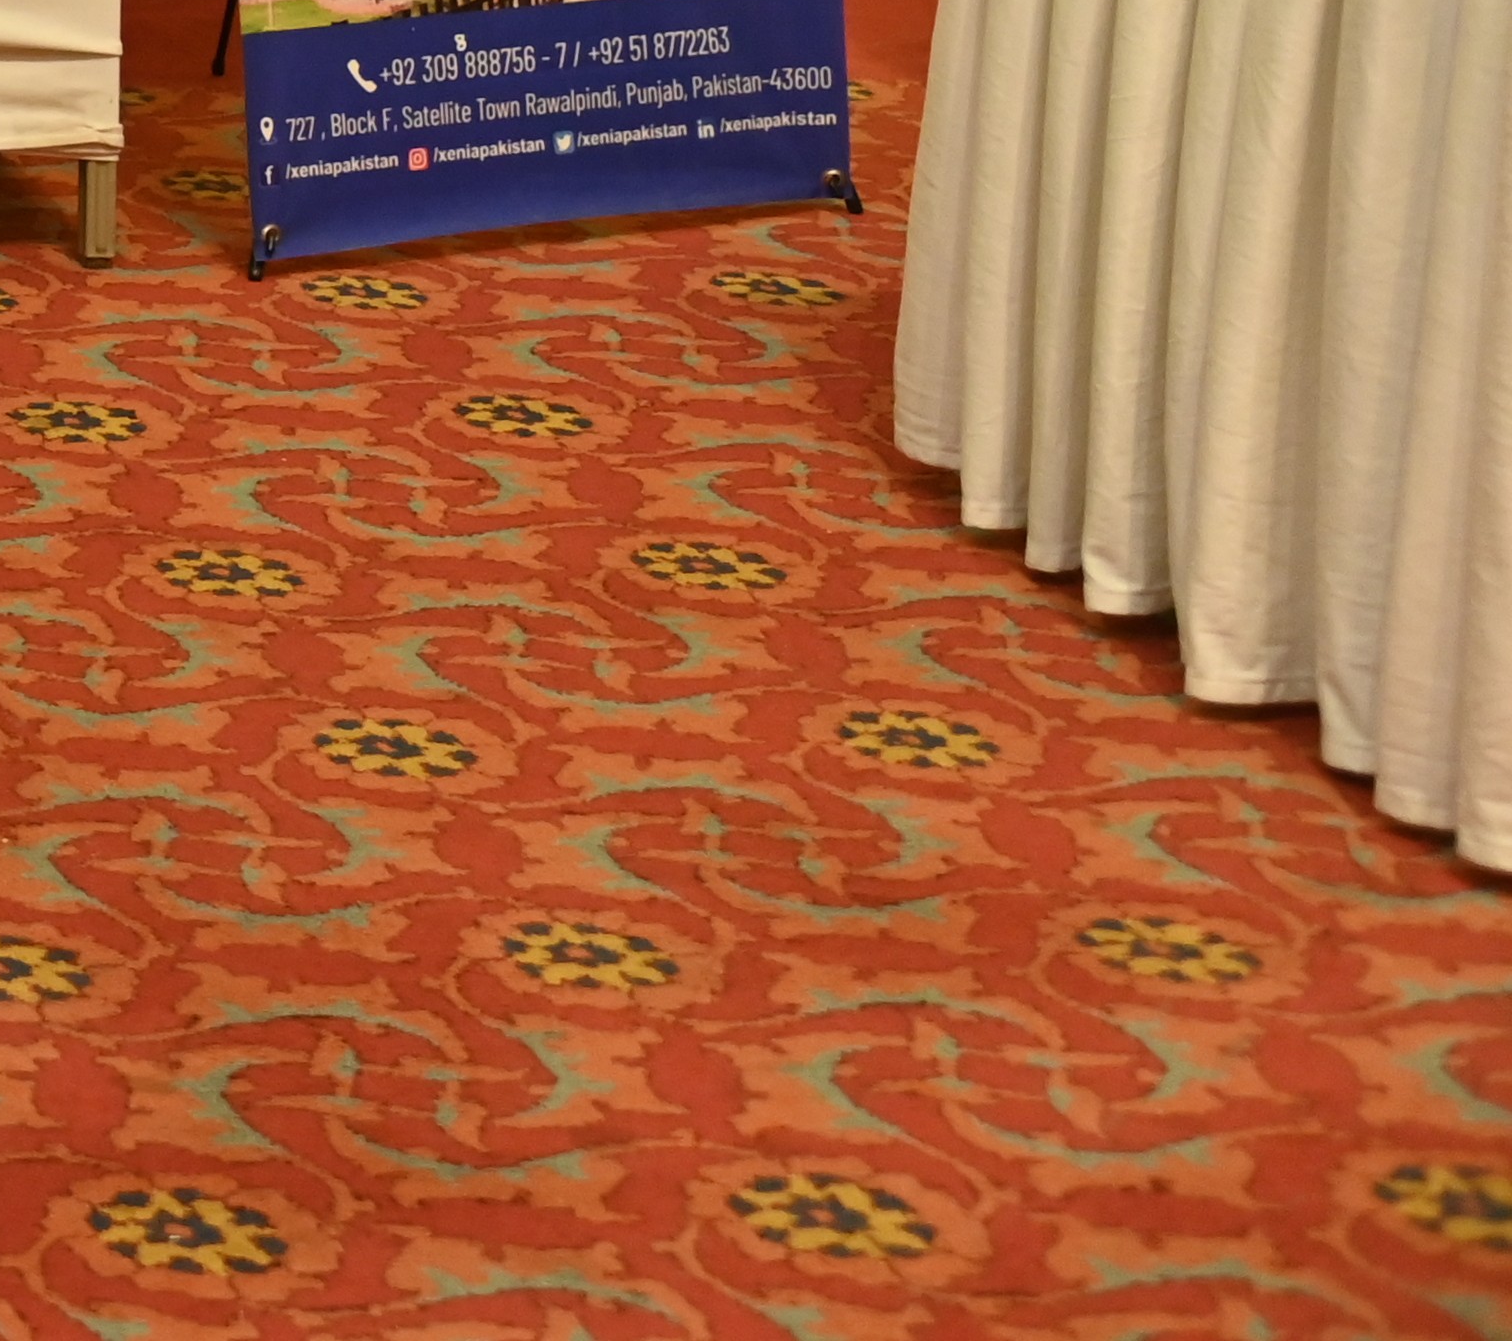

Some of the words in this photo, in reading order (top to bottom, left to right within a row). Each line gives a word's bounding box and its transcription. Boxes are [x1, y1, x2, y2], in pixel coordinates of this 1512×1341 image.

[380, 58, 416, 85] +92
[422, 54, 458, 82] 309
[465, 44, 536, 78] 888756
[555, 42, 566, 68] 7
[589, 37, 623, 64] +92
[629, 35, 647, 61] 51
[654, 26, 729, 59] 8772263
[286, 116, 314, 141] 727
[331, 111, 377, 137] Block
[383, 108, 397, 132] F,
[402, 101, 471, 129] Satellite
[477, 98, 520, 120] Town
[526, 85, 621, 116] Rawalpindi,
[626, 80, 687, 108] Punjab,
[692, 66, 831, 98] Pakistan-43600
[286, 155, 398, 179] /xeniapakistan
[434, 139, 545, 162] /xeniapakistan
[578, 124, 687, 146] /xeniapakistan
[720, 111, 836, 132] /xeniapakistan
